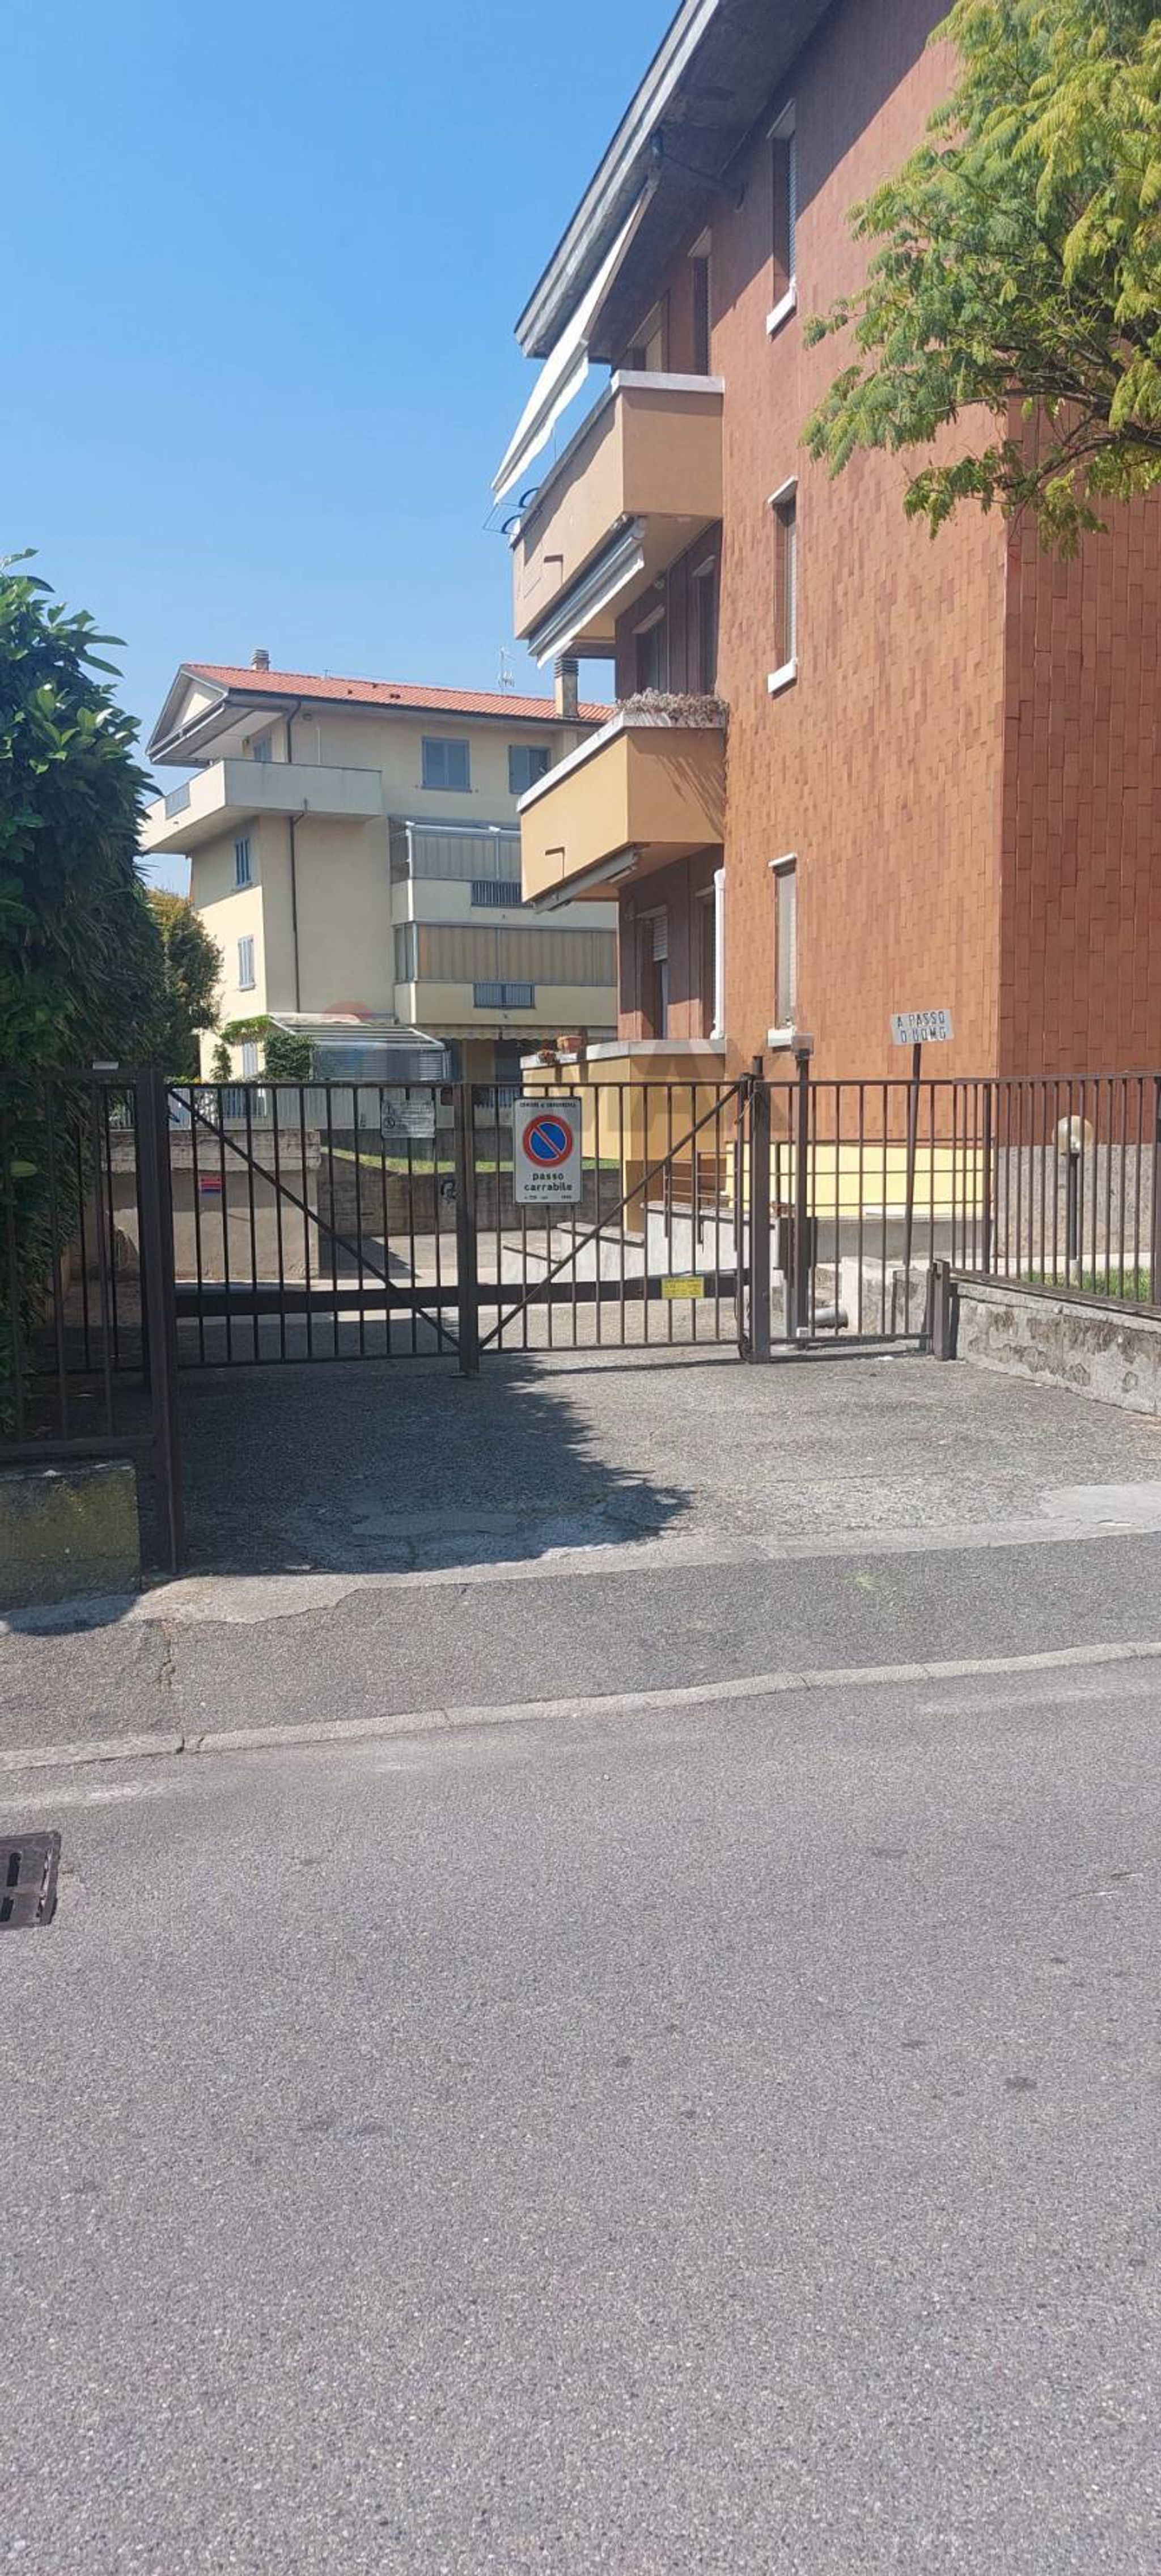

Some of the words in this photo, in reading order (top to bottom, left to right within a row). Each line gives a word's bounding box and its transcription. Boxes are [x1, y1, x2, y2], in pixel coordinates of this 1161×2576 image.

[897, 1015, 902, 1027] A
[908, 1011, 945, 1026] PASSO
[532, 1172, 564, 1181] passo
[524, 1182, 573, 1191] carrabile
